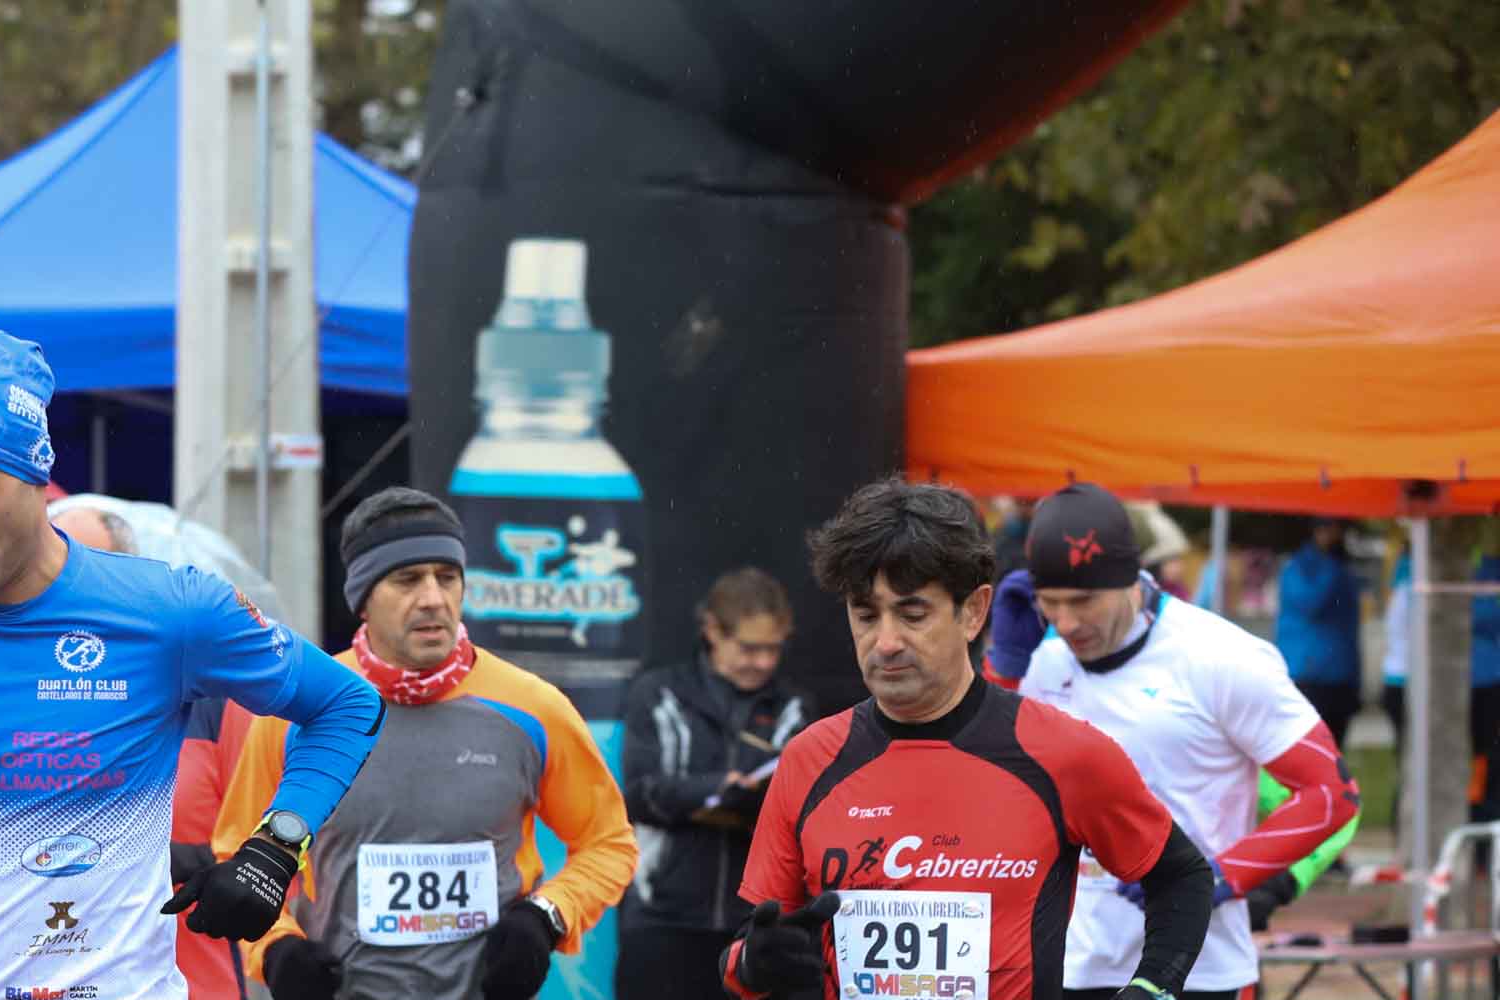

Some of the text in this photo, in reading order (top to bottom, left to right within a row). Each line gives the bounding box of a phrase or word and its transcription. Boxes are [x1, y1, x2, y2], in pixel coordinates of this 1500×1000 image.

[466, 577, 637, 613] OWERADE
[95, 679, 128, 691] CLUB
[12, 731, 93, 749] REDES
[931, 834, 961, 847] Club
[387, 870, 470, 911] 284
[862, 921, 949, 971] 291
